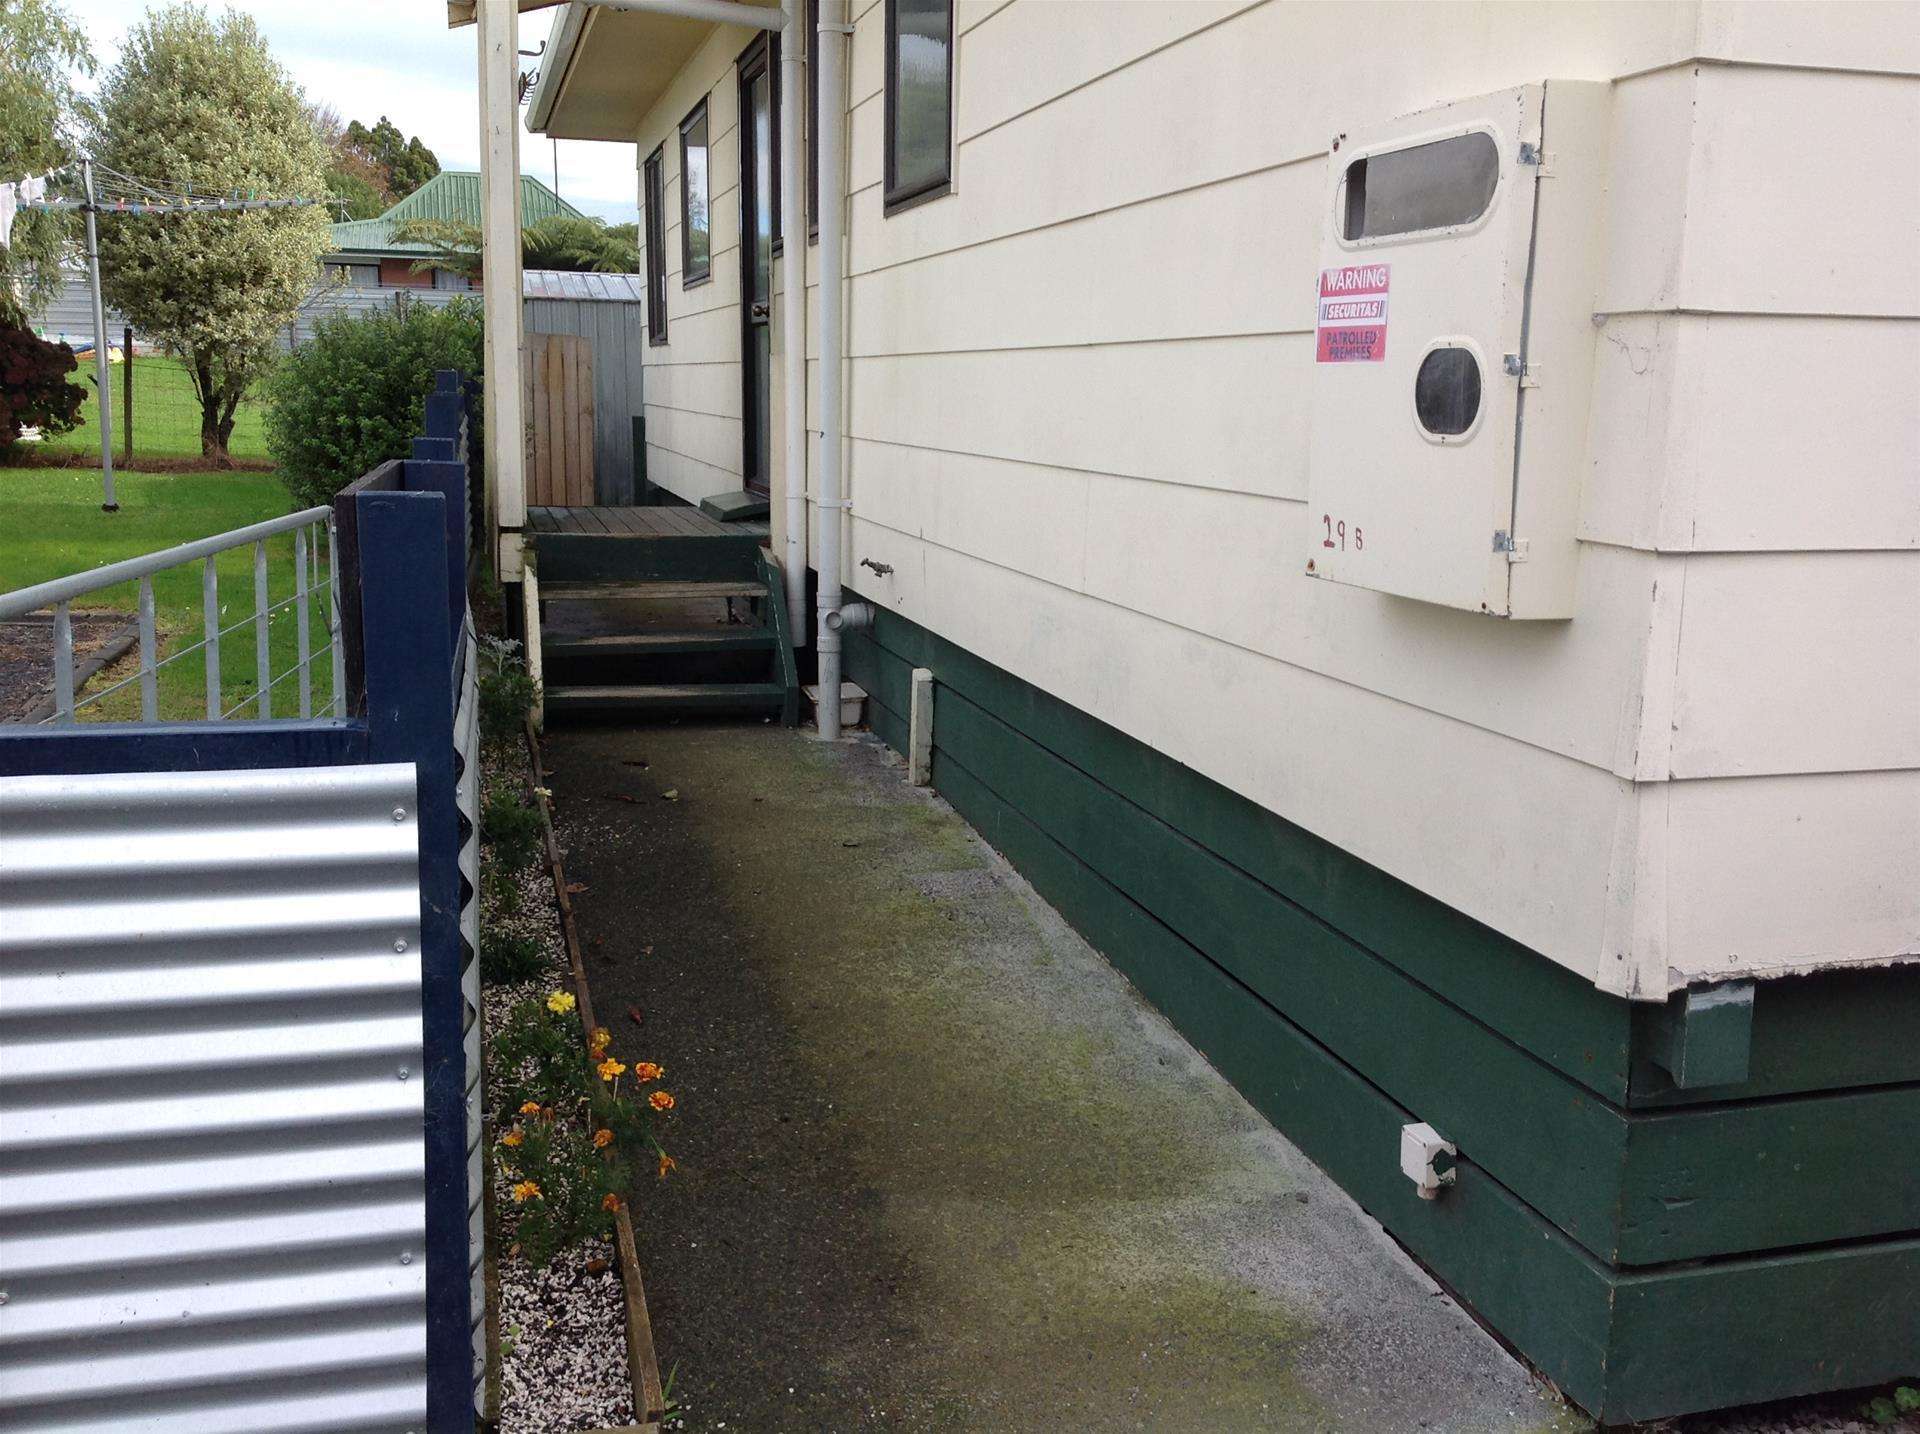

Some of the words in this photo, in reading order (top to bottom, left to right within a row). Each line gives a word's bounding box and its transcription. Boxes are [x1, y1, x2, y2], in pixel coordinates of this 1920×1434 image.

[1324, 267, 1386, 291] WARNING
[1327, 302, 1378, 319] SECURITAS
[1326, 331, 1377, 346] PATROLLED
[1329, 346, 1372, 360] PREMISES
